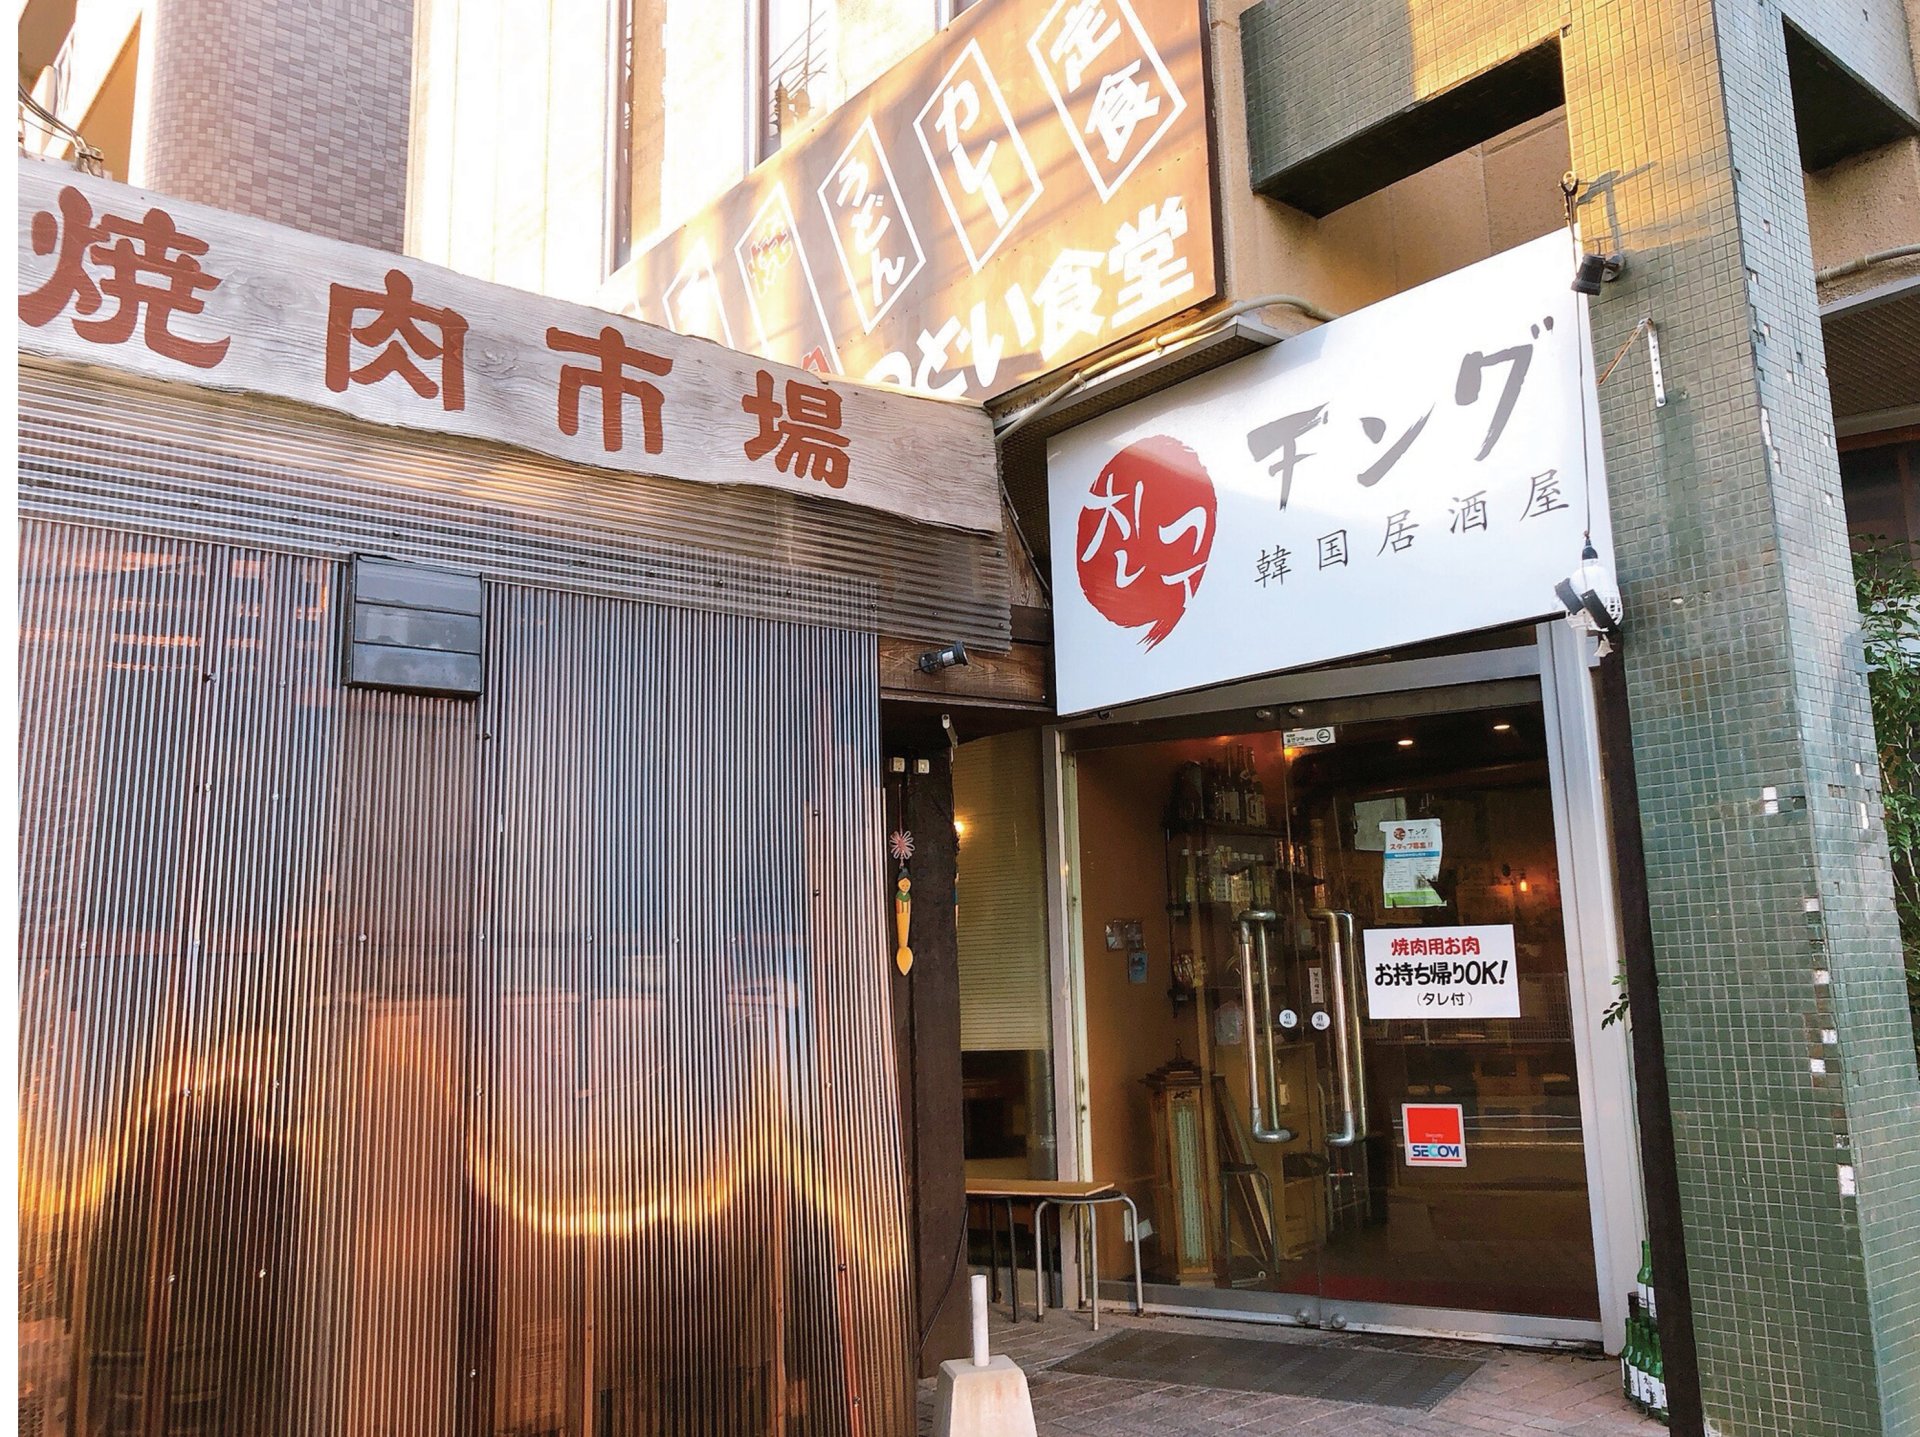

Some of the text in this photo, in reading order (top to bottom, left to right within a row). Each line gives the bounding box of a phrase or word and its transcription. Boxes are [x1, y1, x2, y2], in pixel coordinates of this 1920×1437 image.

[836, 154, 906, 307] うどん
[18, 185, 849, 489] 焼肉市場
[1247, 316, 1555, 511] チング
[1082, 472, 1208, 601] 친구
[1254, 468, 1570, 589] 韓国居酒屋
[1375, 960, 1508, 986] お持ち帰りOK!
[1391, 936, 1481, 956] 焼肉用お肉
[1412, 1145, 1460, 1158] SECOM
